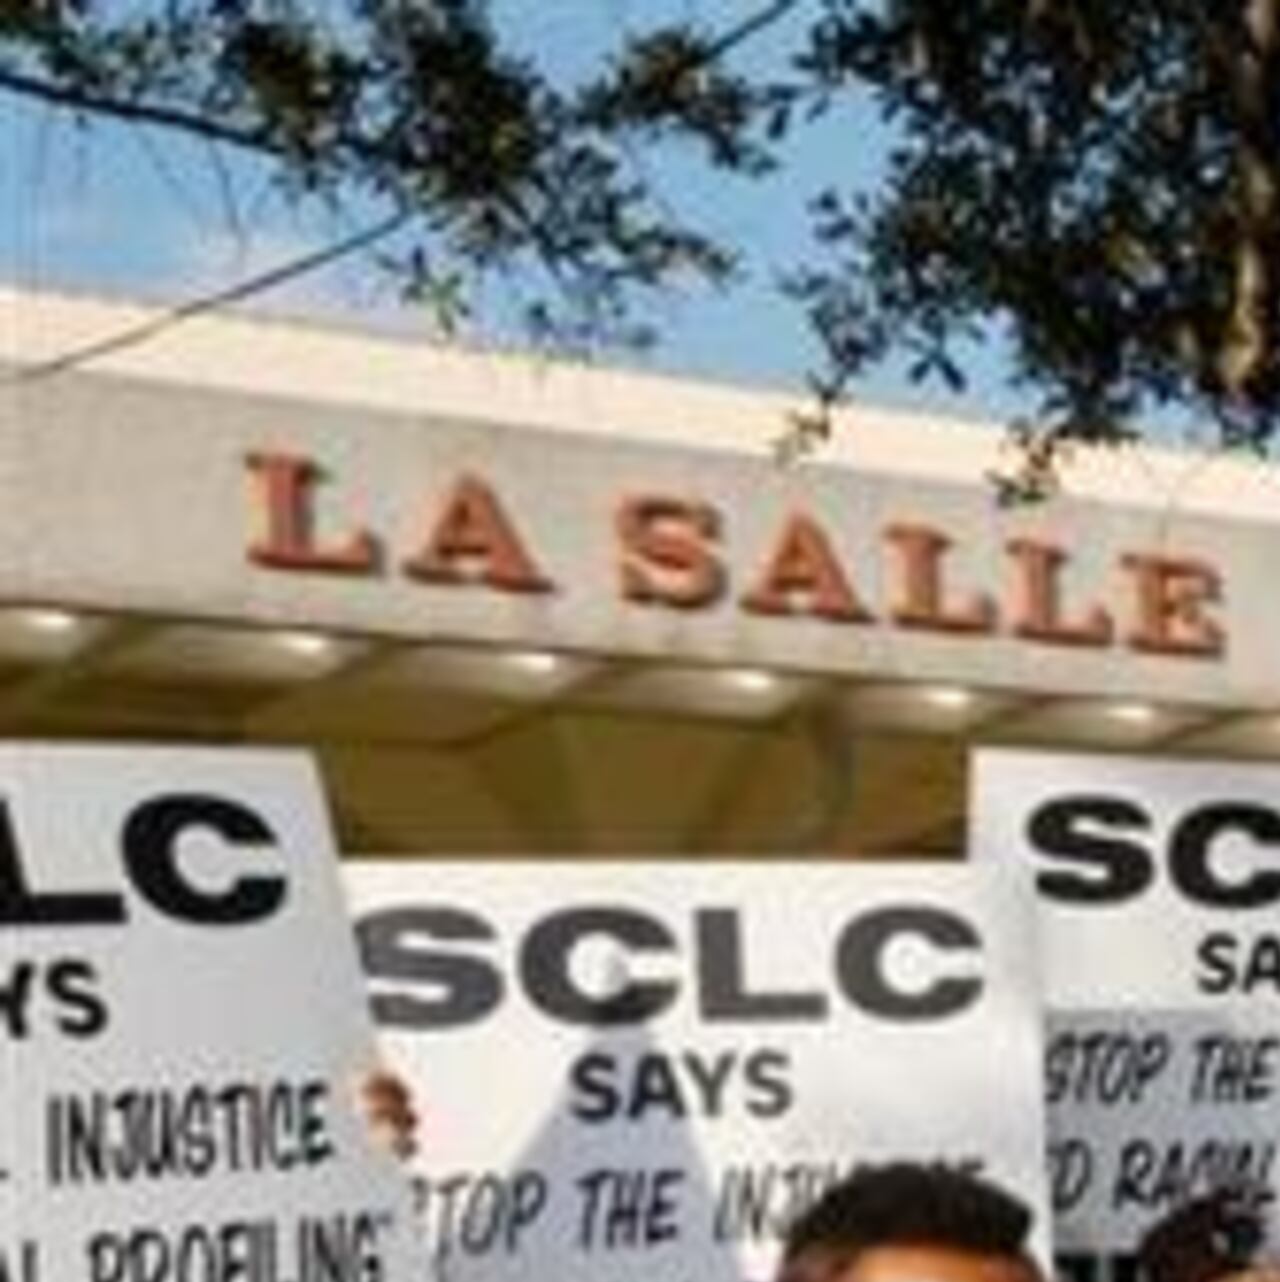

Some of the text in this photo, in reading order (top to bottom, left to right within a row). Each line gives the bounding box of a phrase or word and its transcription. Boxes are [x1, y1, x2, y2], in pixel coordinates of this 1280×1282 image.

[243, 452, 554, 594] LA
[615, 486, 1228, 658] SALLE
[352, 905, 984, 1030] SCLC
[48, 1079, 334, 1187] INJUSTICE
[567, 1048, 794, 1123] SAYS
[574, 1167, 685, 1252] THE
